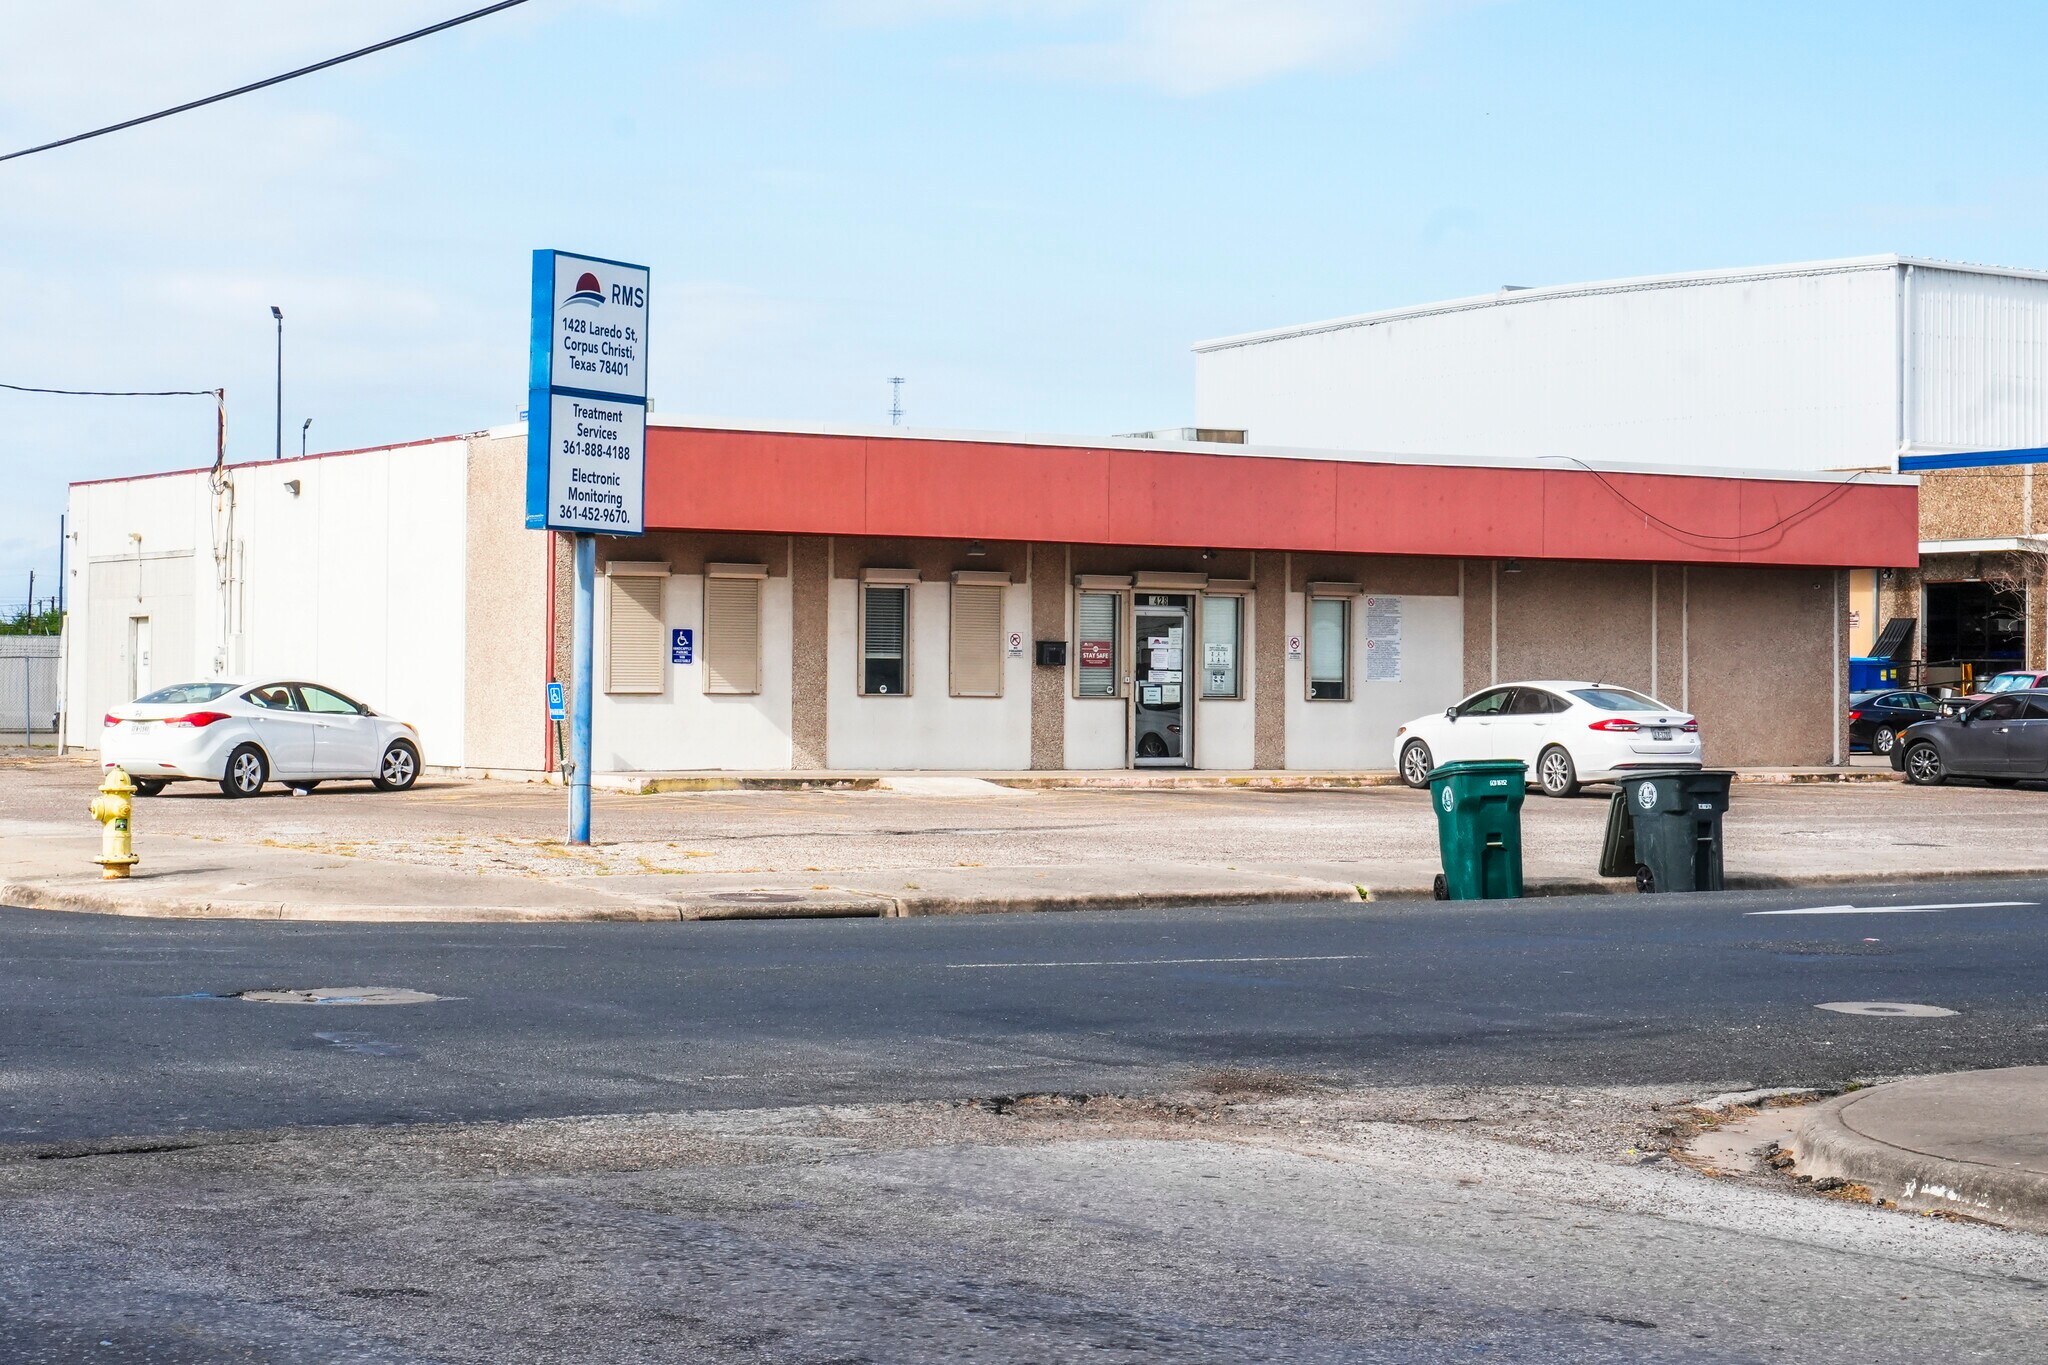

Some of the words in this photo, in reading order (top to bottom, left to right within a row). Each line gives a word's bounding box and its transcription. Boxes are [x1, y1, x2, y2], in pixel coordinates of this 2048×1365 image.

[611, 283, 644, 308] RMS
[562, 317, 586, 333] 1428
[589, 321, 622, 339] Laredo
[625, 327, 638, 343] St,
[564, 336, 599, 356] Corpus
[601, 341, 635, 361] Christi,
[569, 355, 596, 372] Texas
[599, 359, 628, 376] 78401
[573, 403, 623, 423] Treatment
[577, 423, 618, 440] Services
[562, 440, 630, 460] 361-888-4188
[571, 468, 621, 486] Electronic
[568, 486, 623, 508] Monitoring
